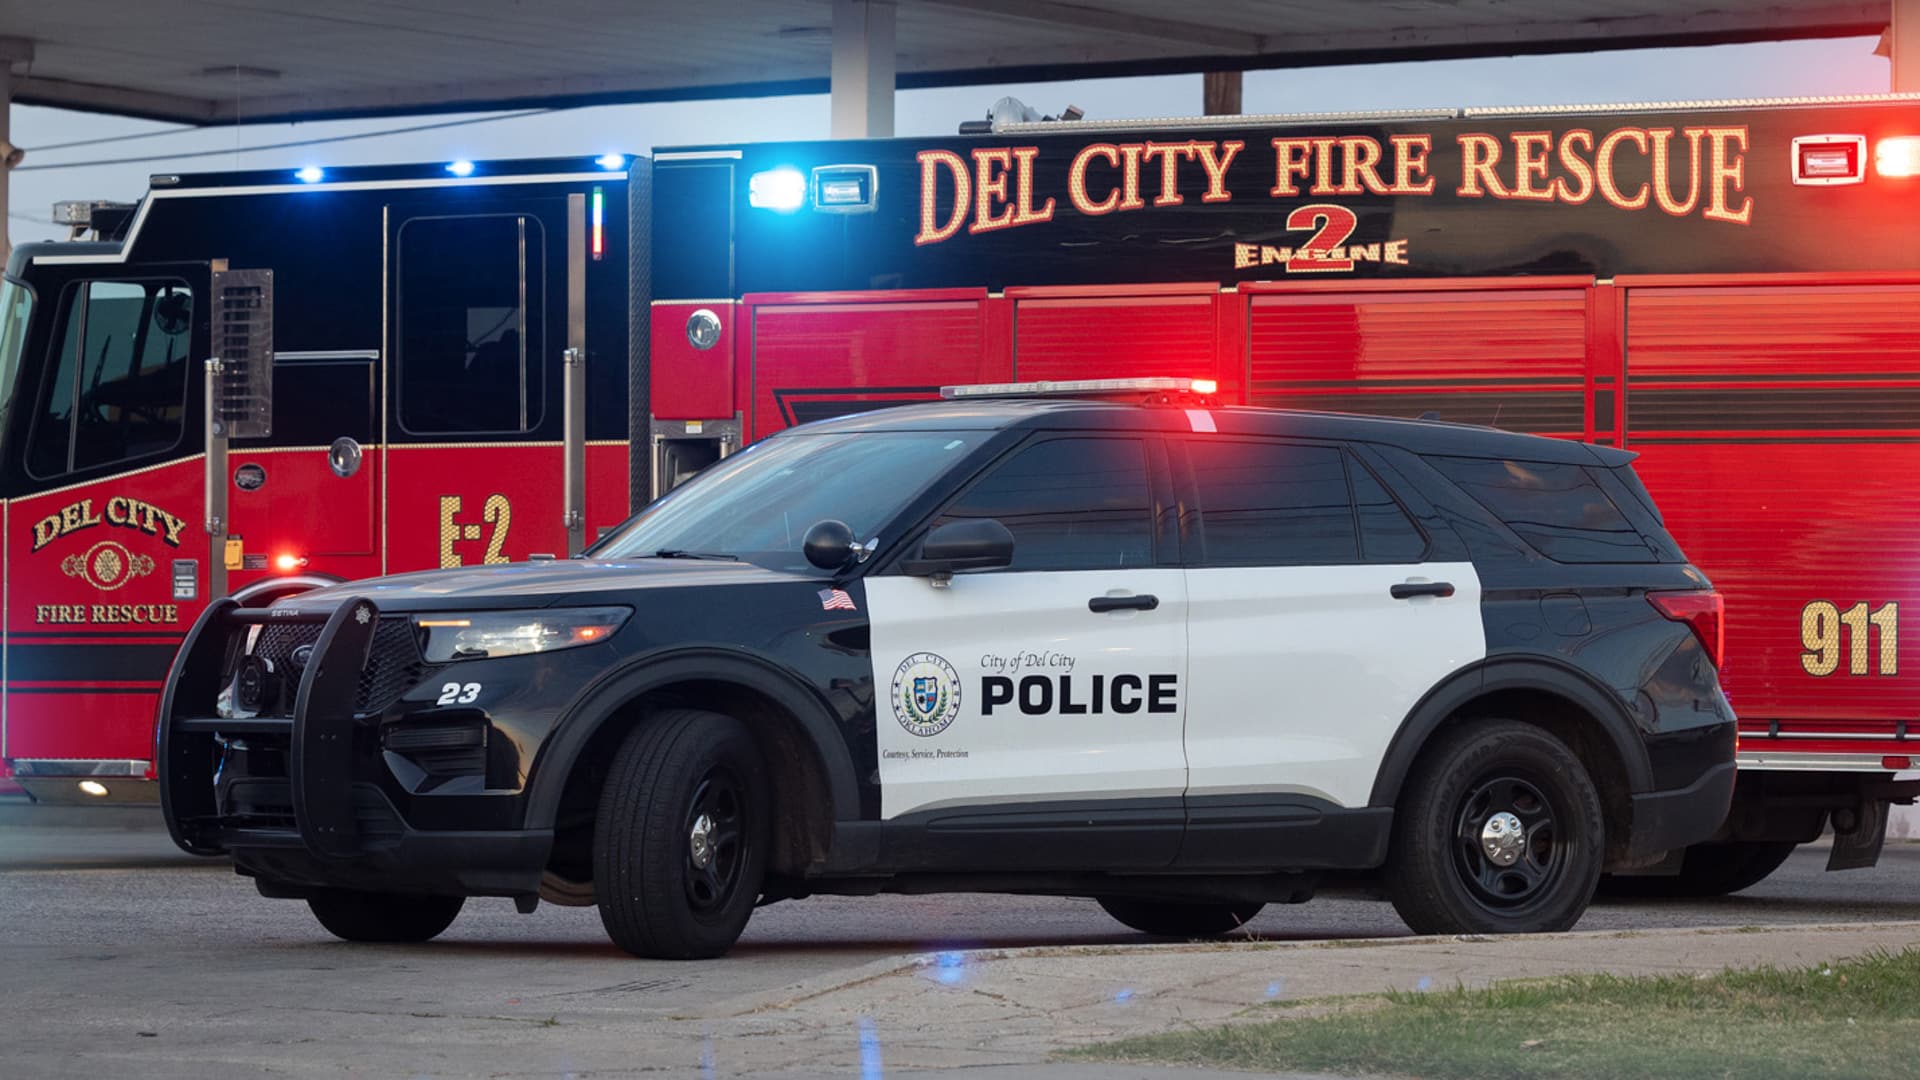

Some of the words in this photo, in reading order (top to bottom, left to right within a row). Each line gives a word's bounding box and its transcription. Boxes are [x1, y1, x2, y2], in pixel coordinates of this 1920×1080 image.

[914, 147, 1056, 246] DEL
[1068, 140, 1245, 216] CITY
[1270, 134, 1436, 198] FIRE
[1456, 125, 1754, 226] RESCUE
[1234, 239, 1409, 269] ENGINE
[1286, 204, 1358, 273] 2
[32, 499, 102, 552] DEL
[105, 496, 186, 548] CITY
[440, 493, 511, 569] E-2
[36, 604, 86, 623] FIRE
[91, 604, 178, 623] RESCUE
[1800, 599, 1899, 677] 911
[900, 656, 919, 673] DEL
[925, 654, 950, 672] CITY
[980, 654, 1007, 673] City
[1010, 650, 1026, 674] of
[1024, 650, 1049, 667] Del
[1049, 653, 1076, 673] City
[436, 682, 482, 705] 23
[981, 674, 1178, 716] POLICE
[900, 713, 953, 735] OKLAHOMA
